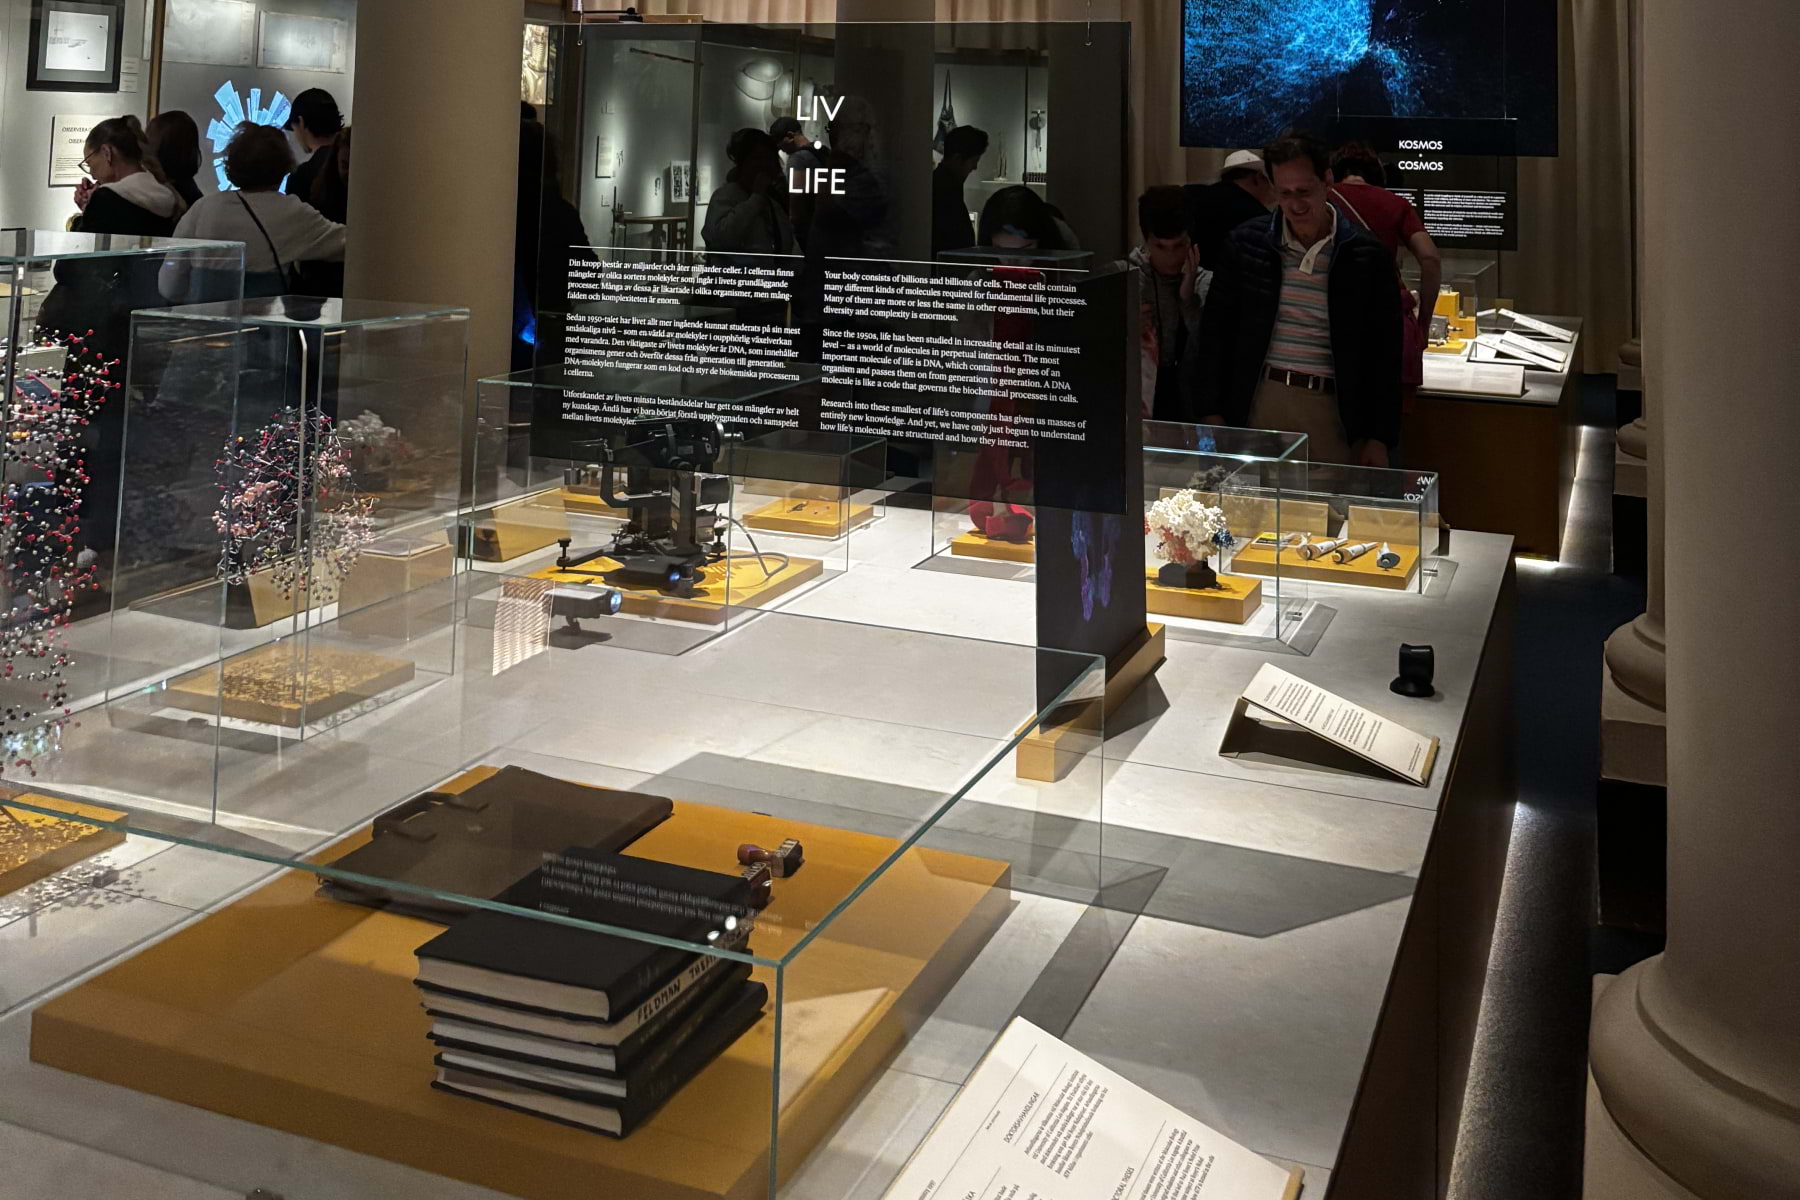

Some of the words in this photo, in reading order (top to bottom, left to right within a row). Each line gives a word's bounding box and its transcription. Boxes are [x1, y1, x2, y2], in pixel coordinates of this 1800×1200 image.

[796, 96, 845, 121] LIV
[1399, 140, 1443, 150] KOSMOS
[1398, 161, 1443, 170] COSMOS
[789, 168, 846, 194] LIFE
[569, 258, 581, 267] Din
[582, 259, 601, 270] kropp
[602, 259, 622, 269] består
[633, 261, 662, 272] miljarder
[663, 262, 676, 271] och
[691, 264, 722, 274] miljarder
[748, 266, 775, 275] cellerna
[777, 267, 794, 276] finns
[568, 270, 597, 280] mängder
[606, 271, 622, 280] olika
[624, 273, 646, 281] sorters
[648, 273, 679, 284] molekyler
[697, 275, 713, 286] ingår
[719, 276, 736, 285] livets
[738, 278, 788, 289] grundläggande
[633, 283, 651, 292] dessa
[695, 286, 712, 295] olika
[825, 271, 842, 280] Your
[843, 272, 860, 283] body
[862, 274, 891, 283] consists
[901, 275, 928, 285] billions
[930, 277, 944, 285] and
[945, 277, 972, 287] billions
[983, 280, 1002, 289] cells.
[1004, 281, 1027, 290] These
[1028, 282, 1046, 291] cells
[1047, 284, 1076, 293] contain
[567, 290, 587, 300] falden
[588, 292, 600, 300] och
[602, 292, 648, 303] komplexiteten
[824, 284, 843, 293] many
[845, 283, 874, 293] different
[875, 285, 895, 294] kinds
[905, 287, 941, 297] molecules
[943, 290, 973, 300] required
[974, 291, 985, 300] for
[986, 291, 1033, 302] fundamental
[1035, 294, 1047, 303] life
[1048, 298, 1088, 306] processes.
[824, 293, 844, 304] Many
[854, 295, 873, 304] them
[917, 299, 931, 308] less
[933, 300, 944, 309] the
[976, 303, 997, 312] other
[998, 306, 1040, 316] organisms,
[1041, 307, 1054, 316] but
[1056, 308, 1075, 317] their
[823, 304, 854, 316] diversity
[855, 307, 869, 315] and
[870, 308, 910, 320] complexity
[919, 313, 959, 321] enormous.
[823, 329, 842, 338] Since
[844, 330, 855, 339] the
[857, 333, 879, 342] 1950s,
[880, 332, 891, 341] life
[893, 333, 905, 342] has
[907, 334, 924, 343] been
[926, 336, 953, 345] studied
[964, 338, 1002, 351] increasing
[1003, 341, 1024, 350] detail
[1035, 343, 1045, 352] its
[1046, 344, 1080, 354] minutest
[823, 340, 839, 350] level
[863, 344, 883, 353] world
[894, 346, 930, 356] molecules
[941, 351, 976, 360] perpetual
[978, 351, 1020, 362] interaction.
[1023, 354, 1038, 363] The
[1040, 357, 1059, 365] most
[822, 352, 858, 363] important
[860, 355, 892, 365] molecule
[902, 357, 914, 366] life
[923, 359, 944, 370] DNA,
[945, 361, 968, 370] which
[969, 364, 1002, 373] contains
[1003, 365, 1016, 374] the
[1017, 368, 1039, 376] genes
[822, 365, 855, 374] organism
[856, 367, 870, 375] and
[872, 370, 896, 378] passes
[897, 369, 916, 378] them
[929, 371, 947, 381] from
[948, 375, 988, 384] generation
[999, 379, 1041, 388] generation.
[1052, 381, 1071, 390] DNA
[822, 375, 853, 385] molecule
[863, 378, 876, 387] like
[883, 380, 900, 389] code
[902, 381, 917, 390] that
[918, 385, 947, 393] governs
[949, 385, 961, 394] the
[963, 386, 1008, 398] biochemical
[1010, 392, 1048, 401] processes
[1059, 394, 1079, 403] cells.
